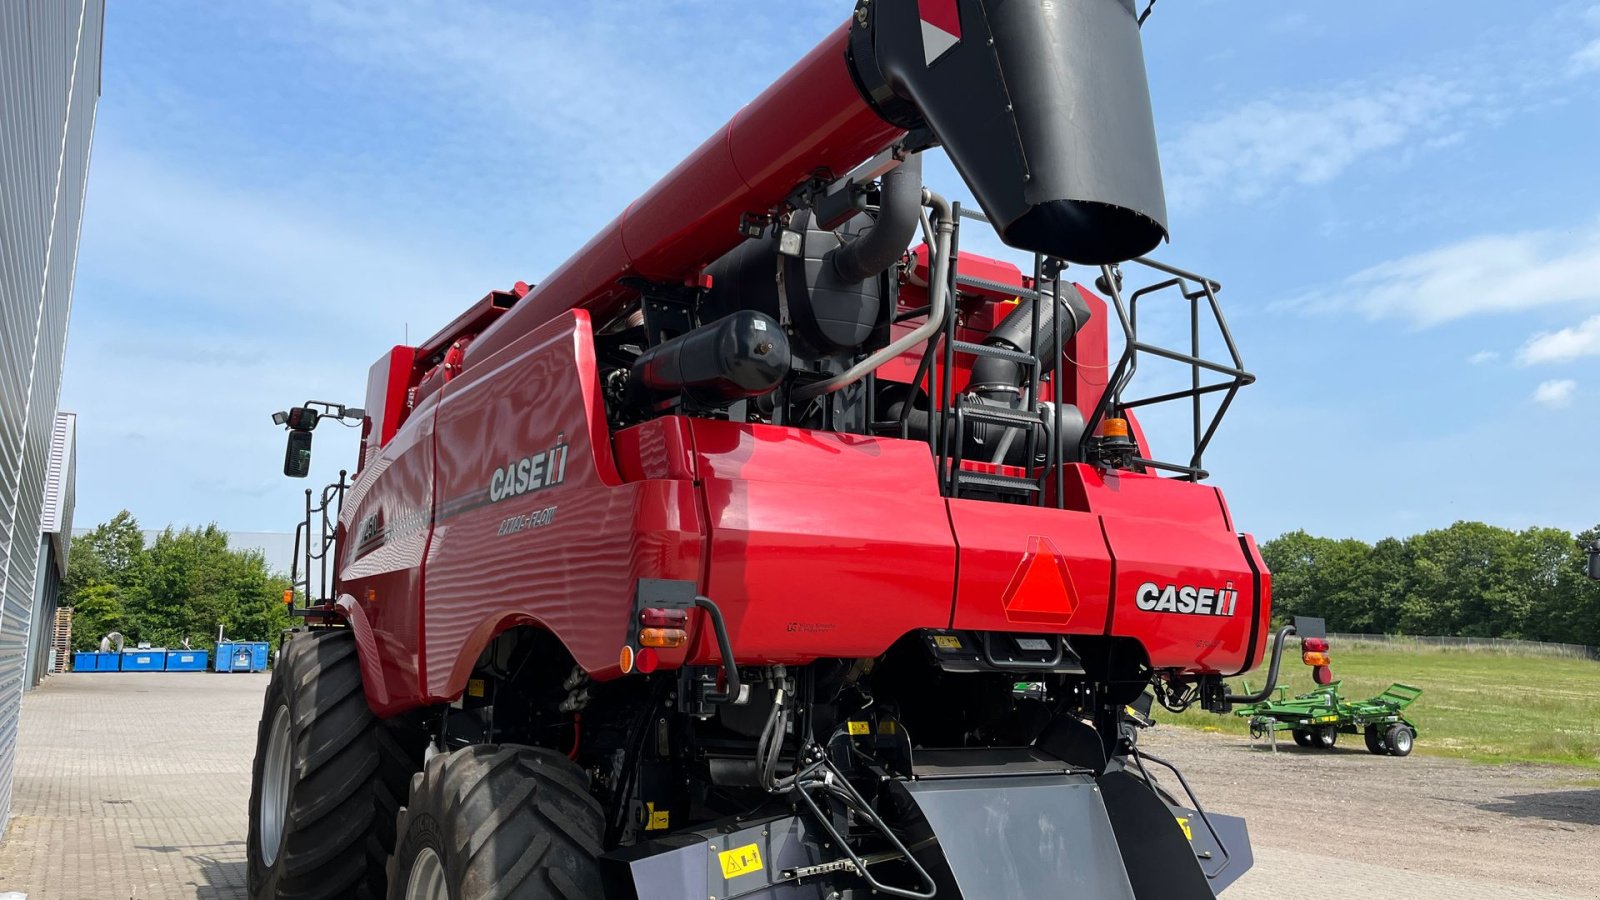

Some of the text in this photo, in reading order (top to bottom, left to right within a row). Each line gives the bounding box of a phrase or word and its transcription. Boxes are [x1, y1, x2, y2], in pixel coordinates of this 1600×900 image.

[490, 452, 546, 502] CASE
[497, 505, 558, 536] AXIAL-FLOW
[1136, 582, 1215, 614] CASE
